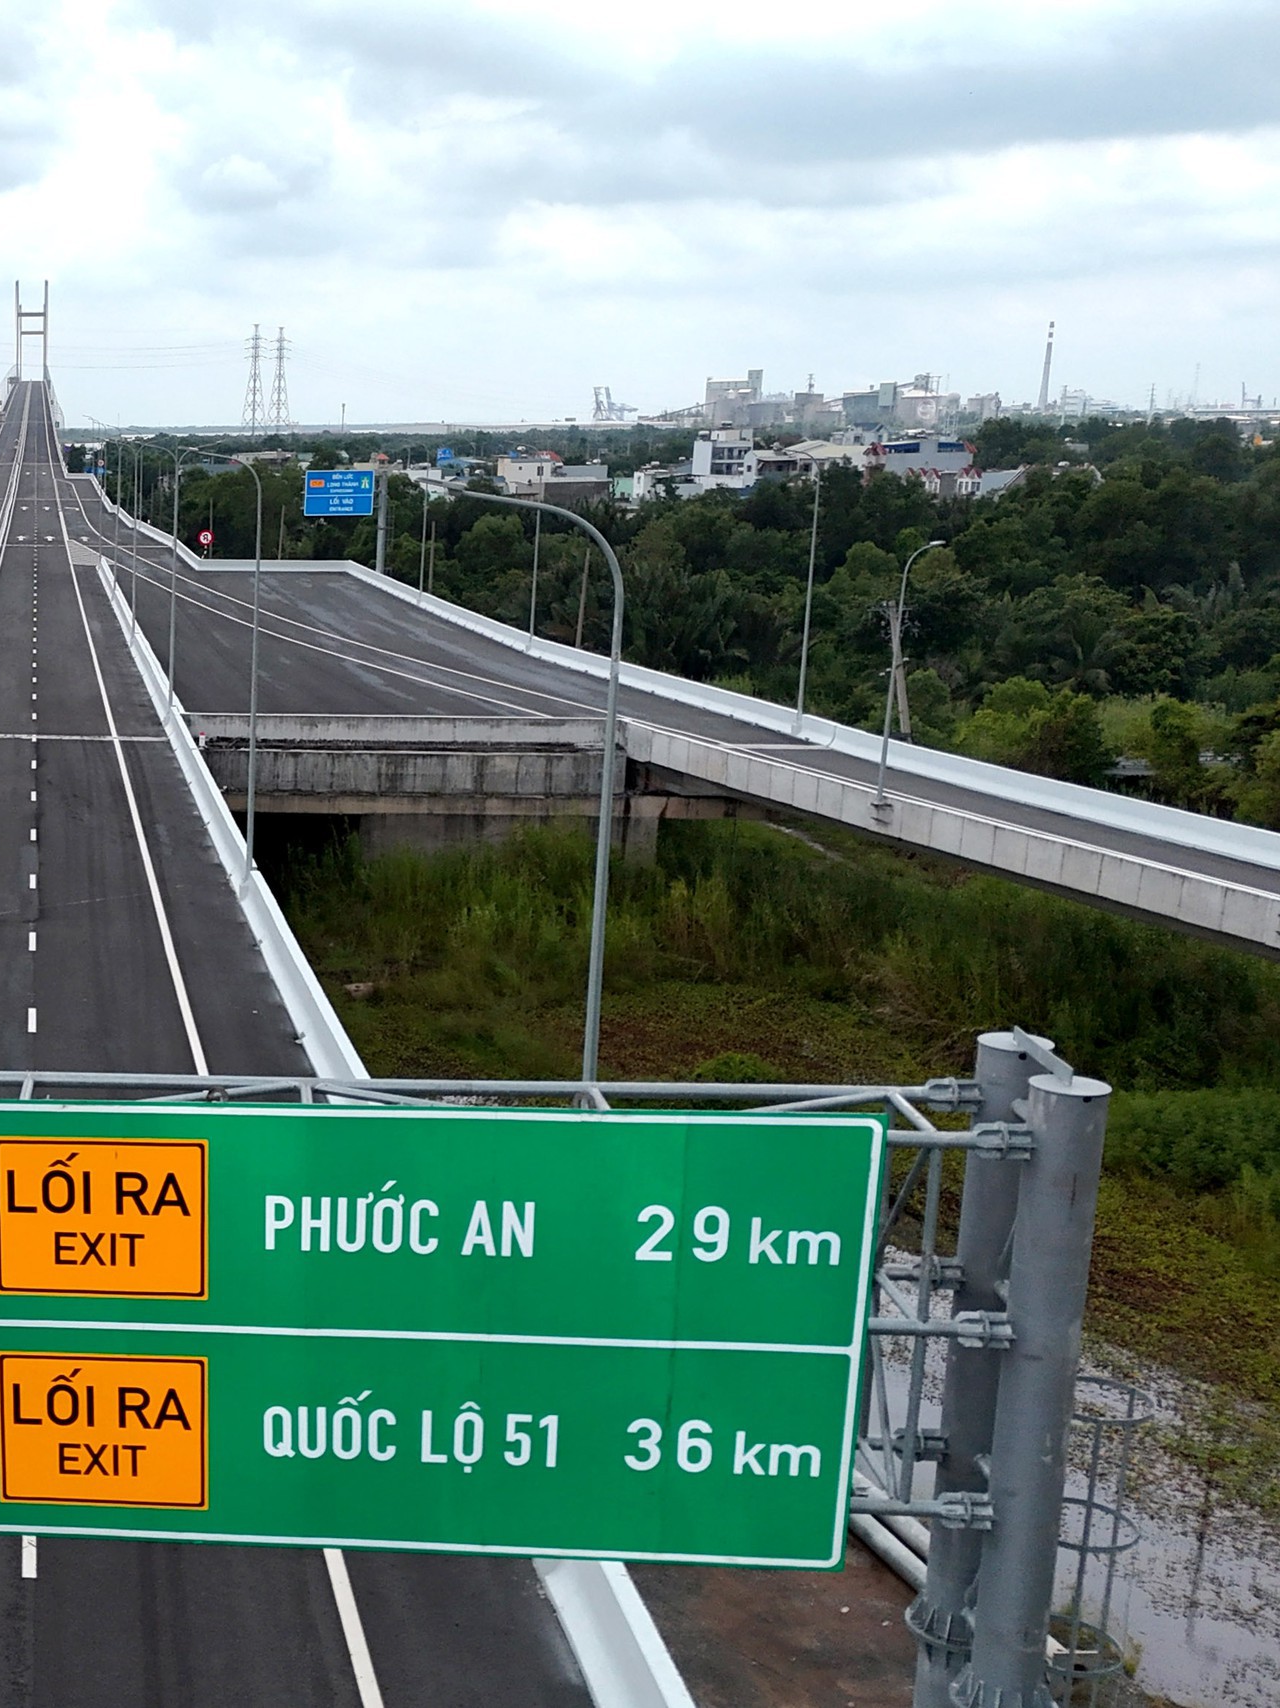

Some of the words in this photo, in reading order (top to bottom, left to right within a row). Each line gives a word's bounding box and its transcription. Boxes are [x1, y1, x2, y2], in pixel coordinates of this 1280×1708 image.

[6, 1152, 92, 1215] LỐI
[114, 1171, 191, 1217] RA
[53, 1231, 145, 1267] EXIT
[264, 1180, 440, 1255] PHƯỚC
[460, 1200, 536, 1258] AN
[634, 1204, 731, 1263] 29
[748, 1216, 842, 1266] km
[11, 1368, 95, 1428] LỐI
[117, 1386, 192, 1431] RA
[57, 1442, 147, 1477] EXIT
[262, 1390, 397, 1461] QUỐC
[419, 1401, 484, 1474] LỘ
[503, 1413, 560, 1469] 51
[623, 1417, 713, 1474] 36
[732, 1430, 821, 1478] km
